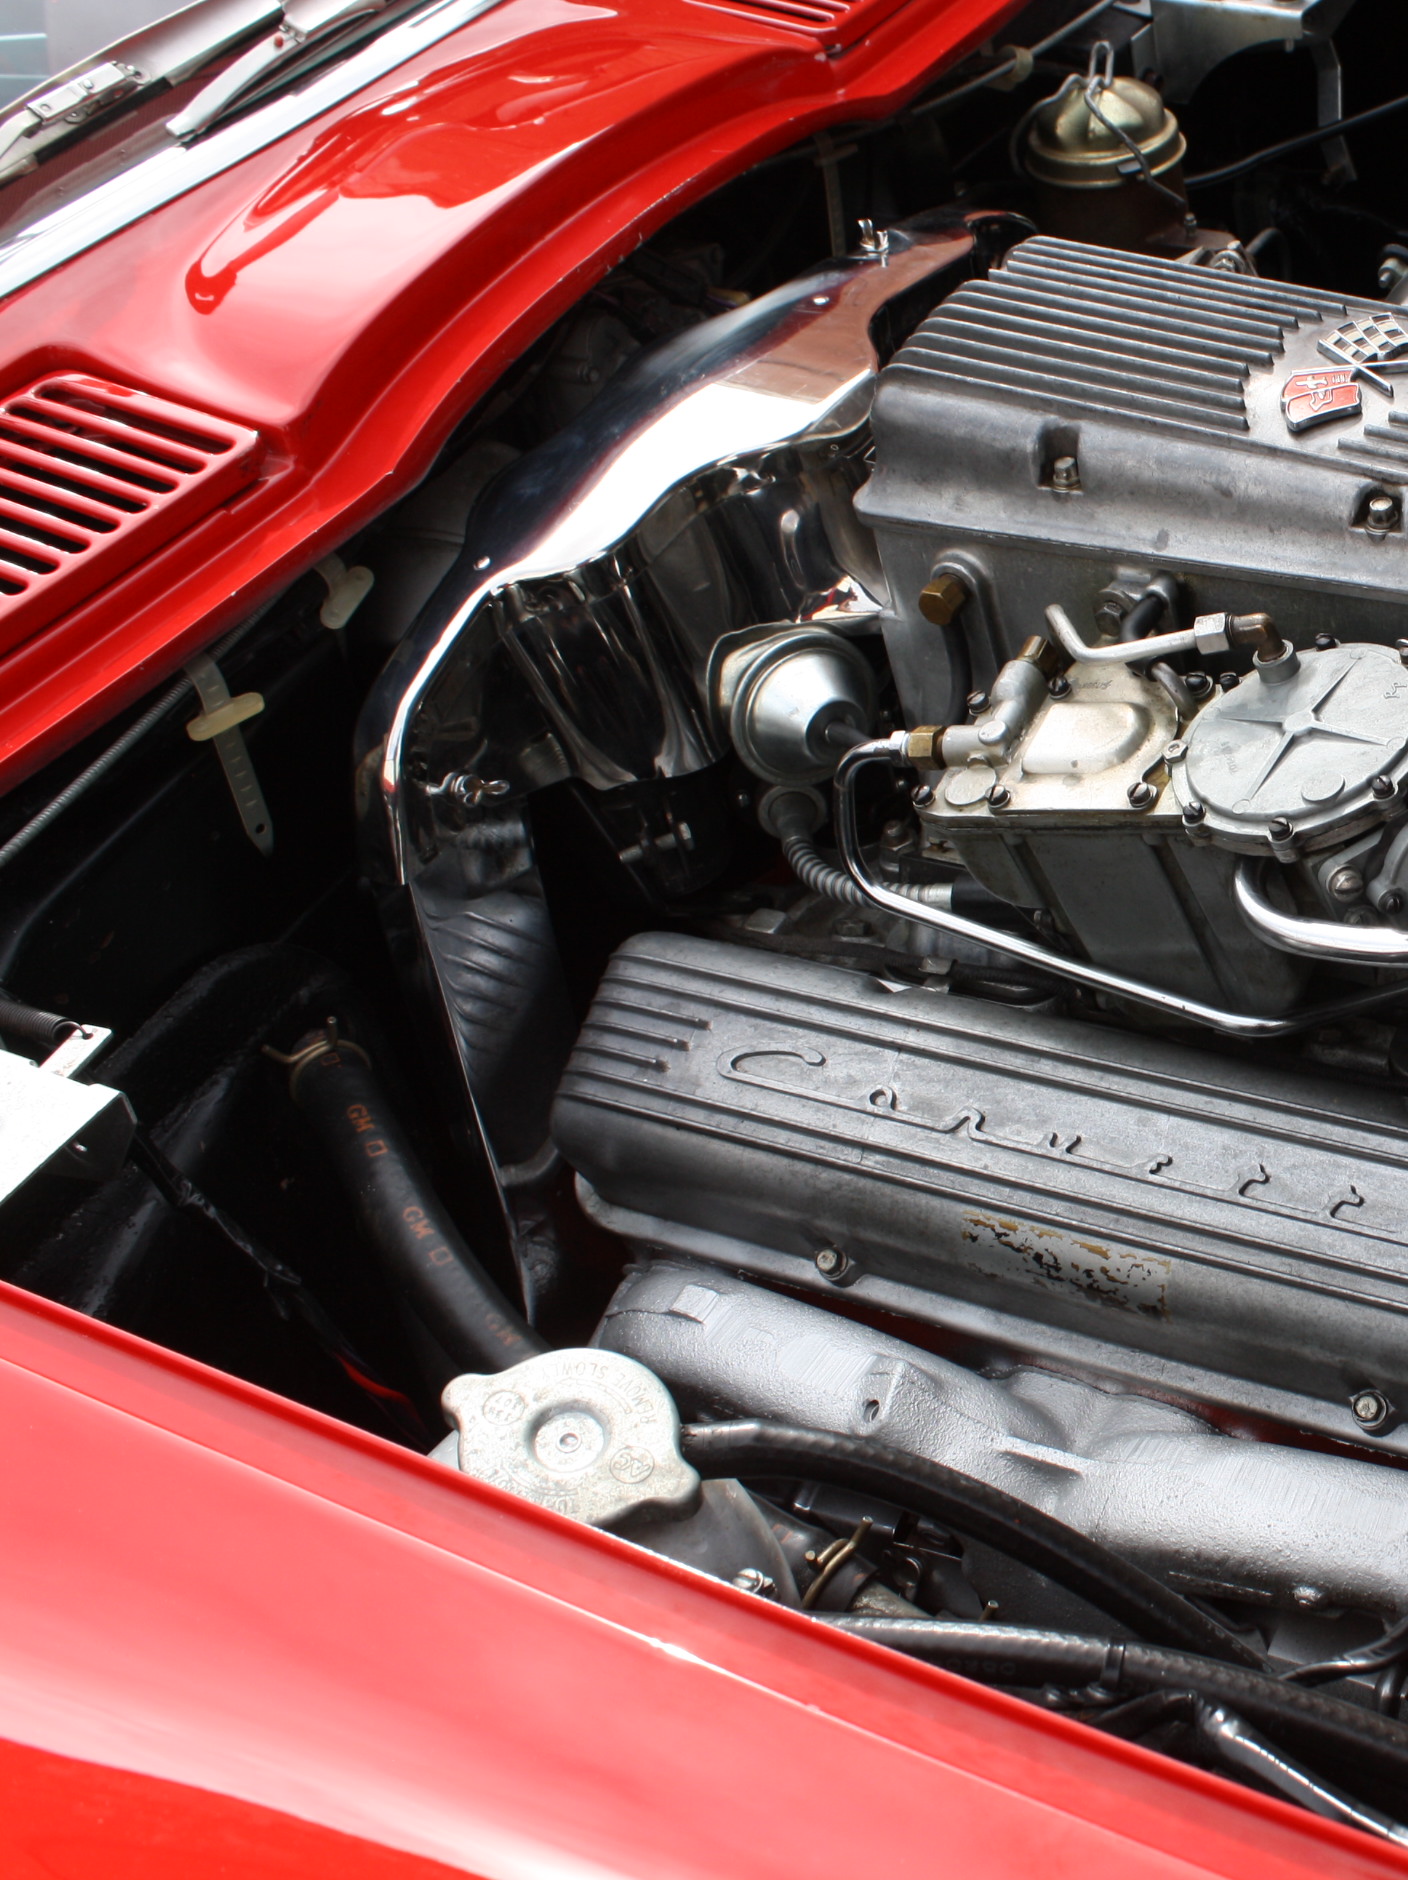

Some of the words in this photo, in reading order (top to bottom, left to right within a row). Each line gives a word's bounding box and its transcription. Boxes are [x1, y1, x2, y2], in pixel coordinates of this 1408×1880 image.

[345, 1103, 374, 1133] GM
[402, 1205, 434, 1239] GM
[542, 1360, 608, 1380] SLOWLY
[612, 1372, 657, 1422] REMOVE
[614, 1452, 651, 1478] AC
